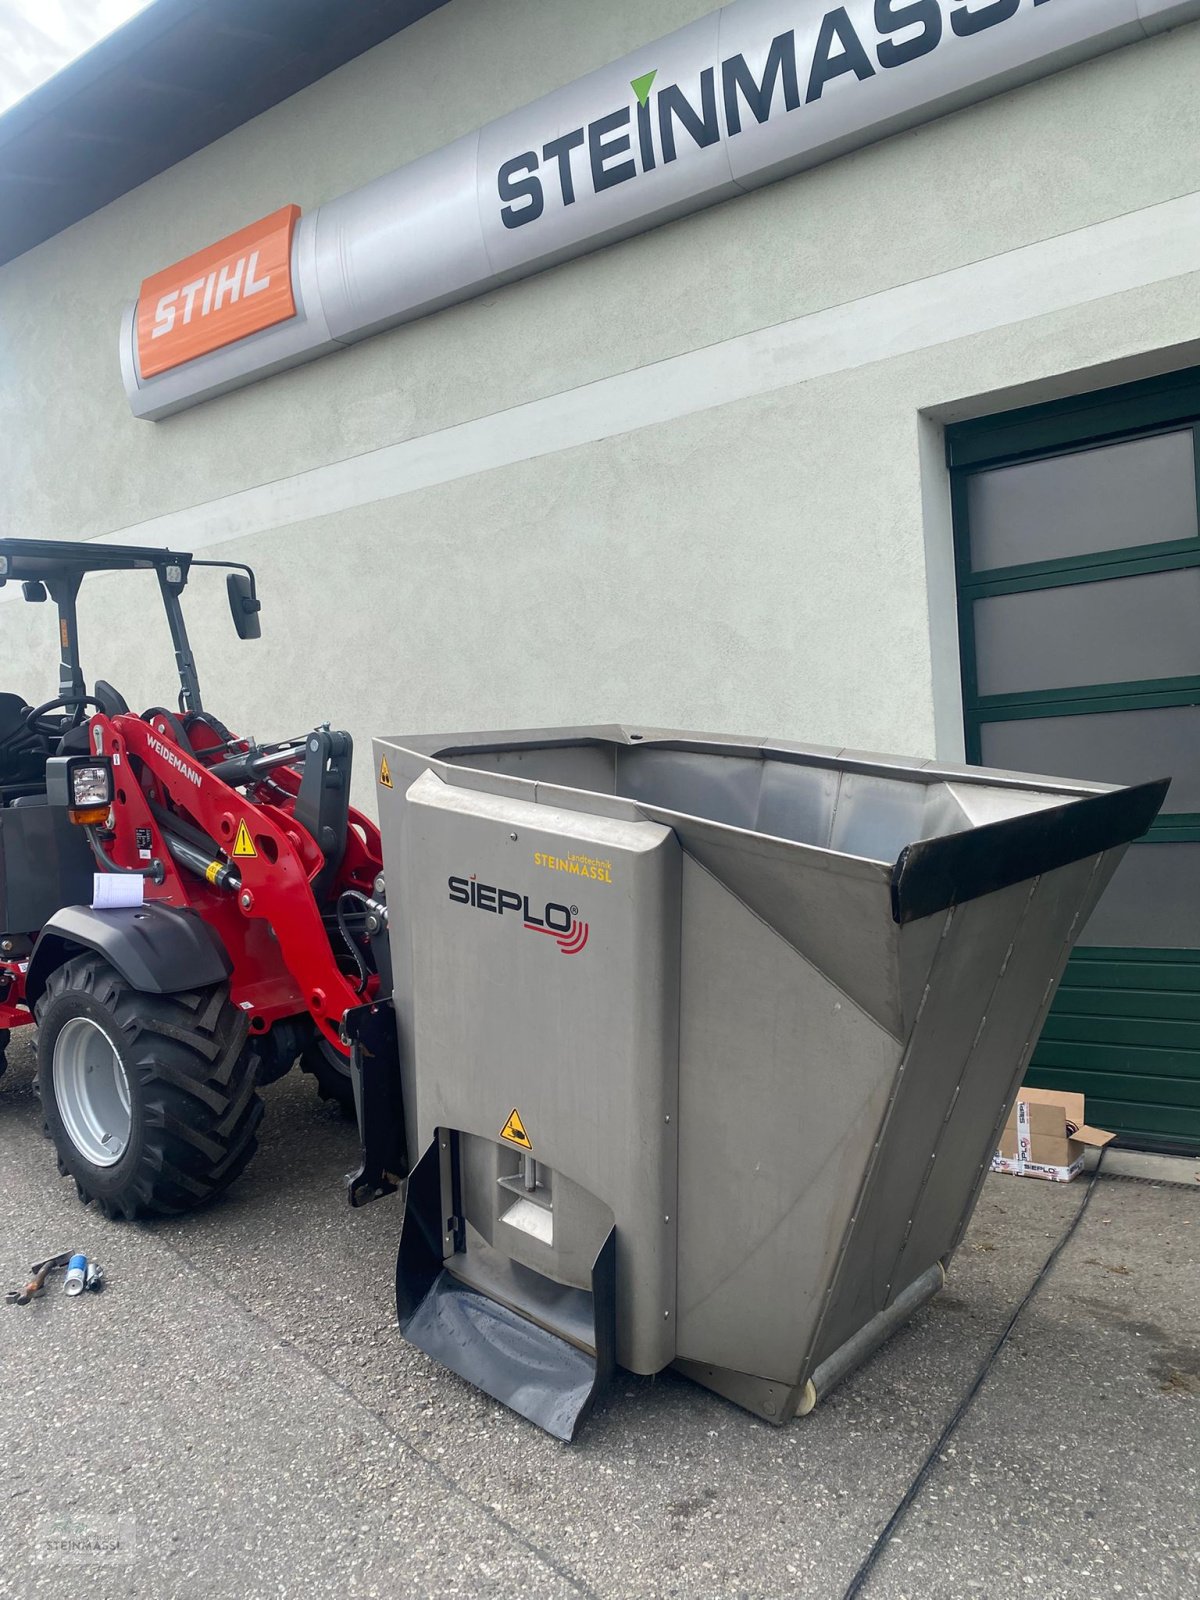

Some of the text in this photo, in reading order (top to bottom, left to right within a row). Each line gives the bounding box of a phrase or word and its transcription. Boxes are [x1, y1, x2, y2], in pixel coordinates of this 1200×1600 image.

[498, 0, 1051, 229] STEINMAS
[151, 251, 270, 339] STIHL
[147, 733, 202, 788] WEIDEMANN
[534, 852, 612, 883] STEINMASSL
